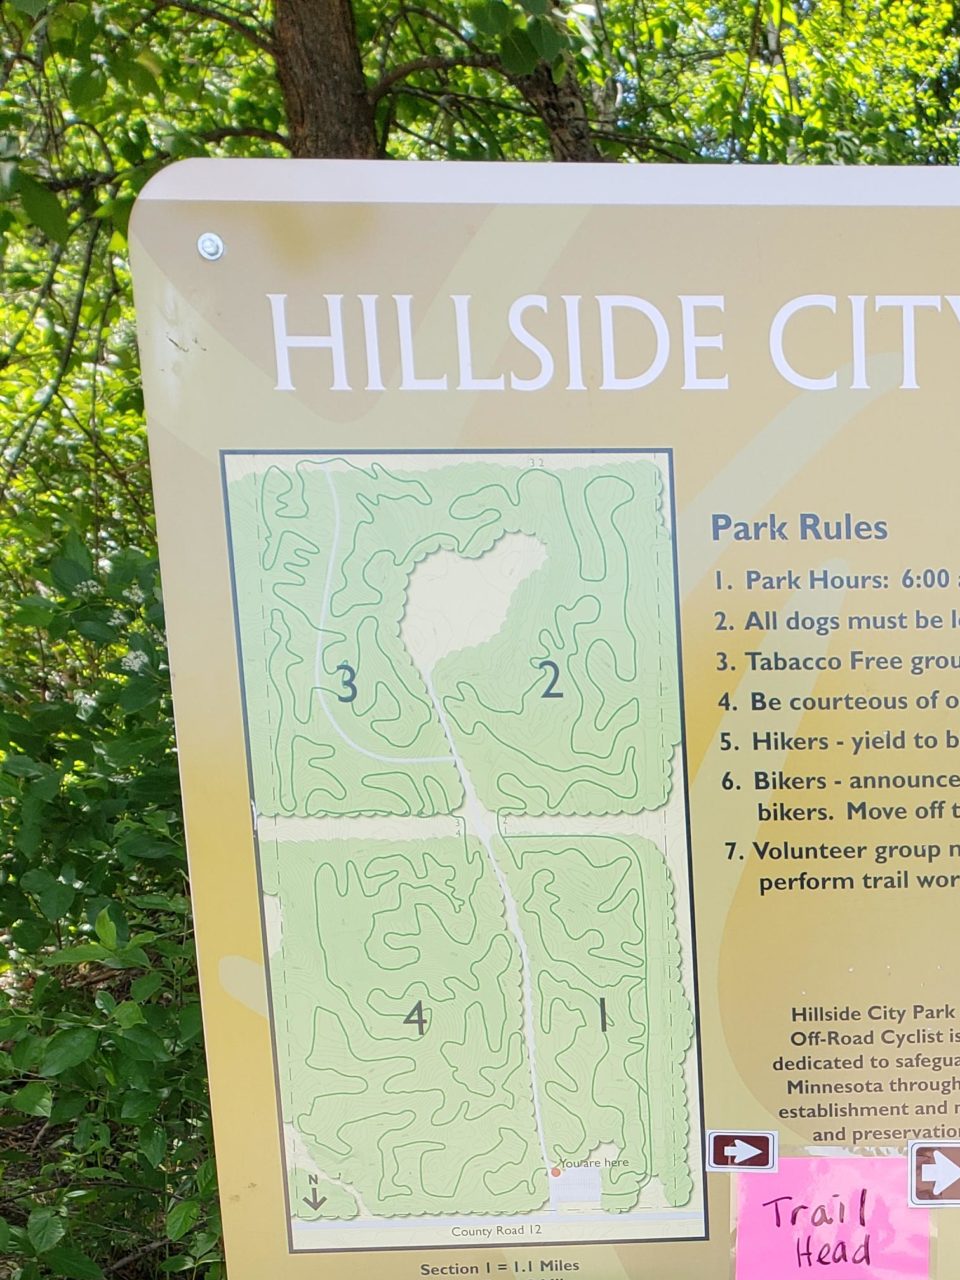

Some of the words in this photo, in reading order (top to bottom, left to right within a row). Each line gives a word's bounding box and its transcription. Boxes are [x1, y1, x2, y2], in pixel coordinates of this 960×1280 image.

[266, 293, 729, 391] HILLSIDE
[711, 513, 788, 541] Park
[799, 512, 888, 540] Rules
[746, 569, 802, 590] Park
[809, 569, 888, 589] Hours:
[901, 568, 950, 589] 6:00
[744, 610, 777, 630] All
[785, 610, 840, 636] dogs
[848, 612, 908, 629] must
[915, 609, 943, 629] be
[744, 651, 842, 671] Tabacco
[850, 650, 903, 670] Free
[336, 664, 358, 703] 3
[538, 660, 564, 698] 2
[750, 691, 782, 711] Be
[789, 693, 908, 711] courteous
[915, 689, 940, 709] of
[752, 731, 828, 751] Hikers
[851, 730, 905, 755] yield
[913, 732, 938, 749] to
[754, 770, 826, 790] Bikers
[849, 774, 960, 789] announce
[757, 802, 834, 821] bikers.
[846, 801, 907, 820] Move
[915, 800, 946, 819] off
[751, 841, 868, 859] Volunteer
[874, 845, 942, 865] group
[759, 871, 854, 896] perform
[862, 870, 908, 889] trail
[403, 1000, 428, 1036] 4
[599, 997, 608, 1033] 1
[791, 1005, 861, 1022] Hillside
[867, 1005, 906, 1024] City
[912, 1003, 956, 1020] Park
[790, 1029, 874, 1046] Off-Road
[880, 1028, 944, 1048] Cyclist
[772, 1054, 864, 1071] dedicated
[869, 1055, 890, 1069] to
[787, 1079, 884, 1095] Minnesota
[778, 1102, 909, 1119] establishment
[914, 1099, 948, 1115] and
[812, 1126, 846, 1142] and
[559, 1158, 581, 1169] You
[582, 1160, 601, 1169] are
[603, 1157, 629, 1168] here
[308, 1174, 319, 1185] N
[763, 1188, 868, 1228] Trail
[451, 1226, 493, 1239] County
[496, 1224, 524, 1235] Road
[529, 1224, 542, 1234] 12
[796, 1234, 871, 1268] Head
[420, 1262, 479, 1276] Section
[514, 1260, 532, 1272] 1.1
[540, 1259, 580, 1272] Miles
